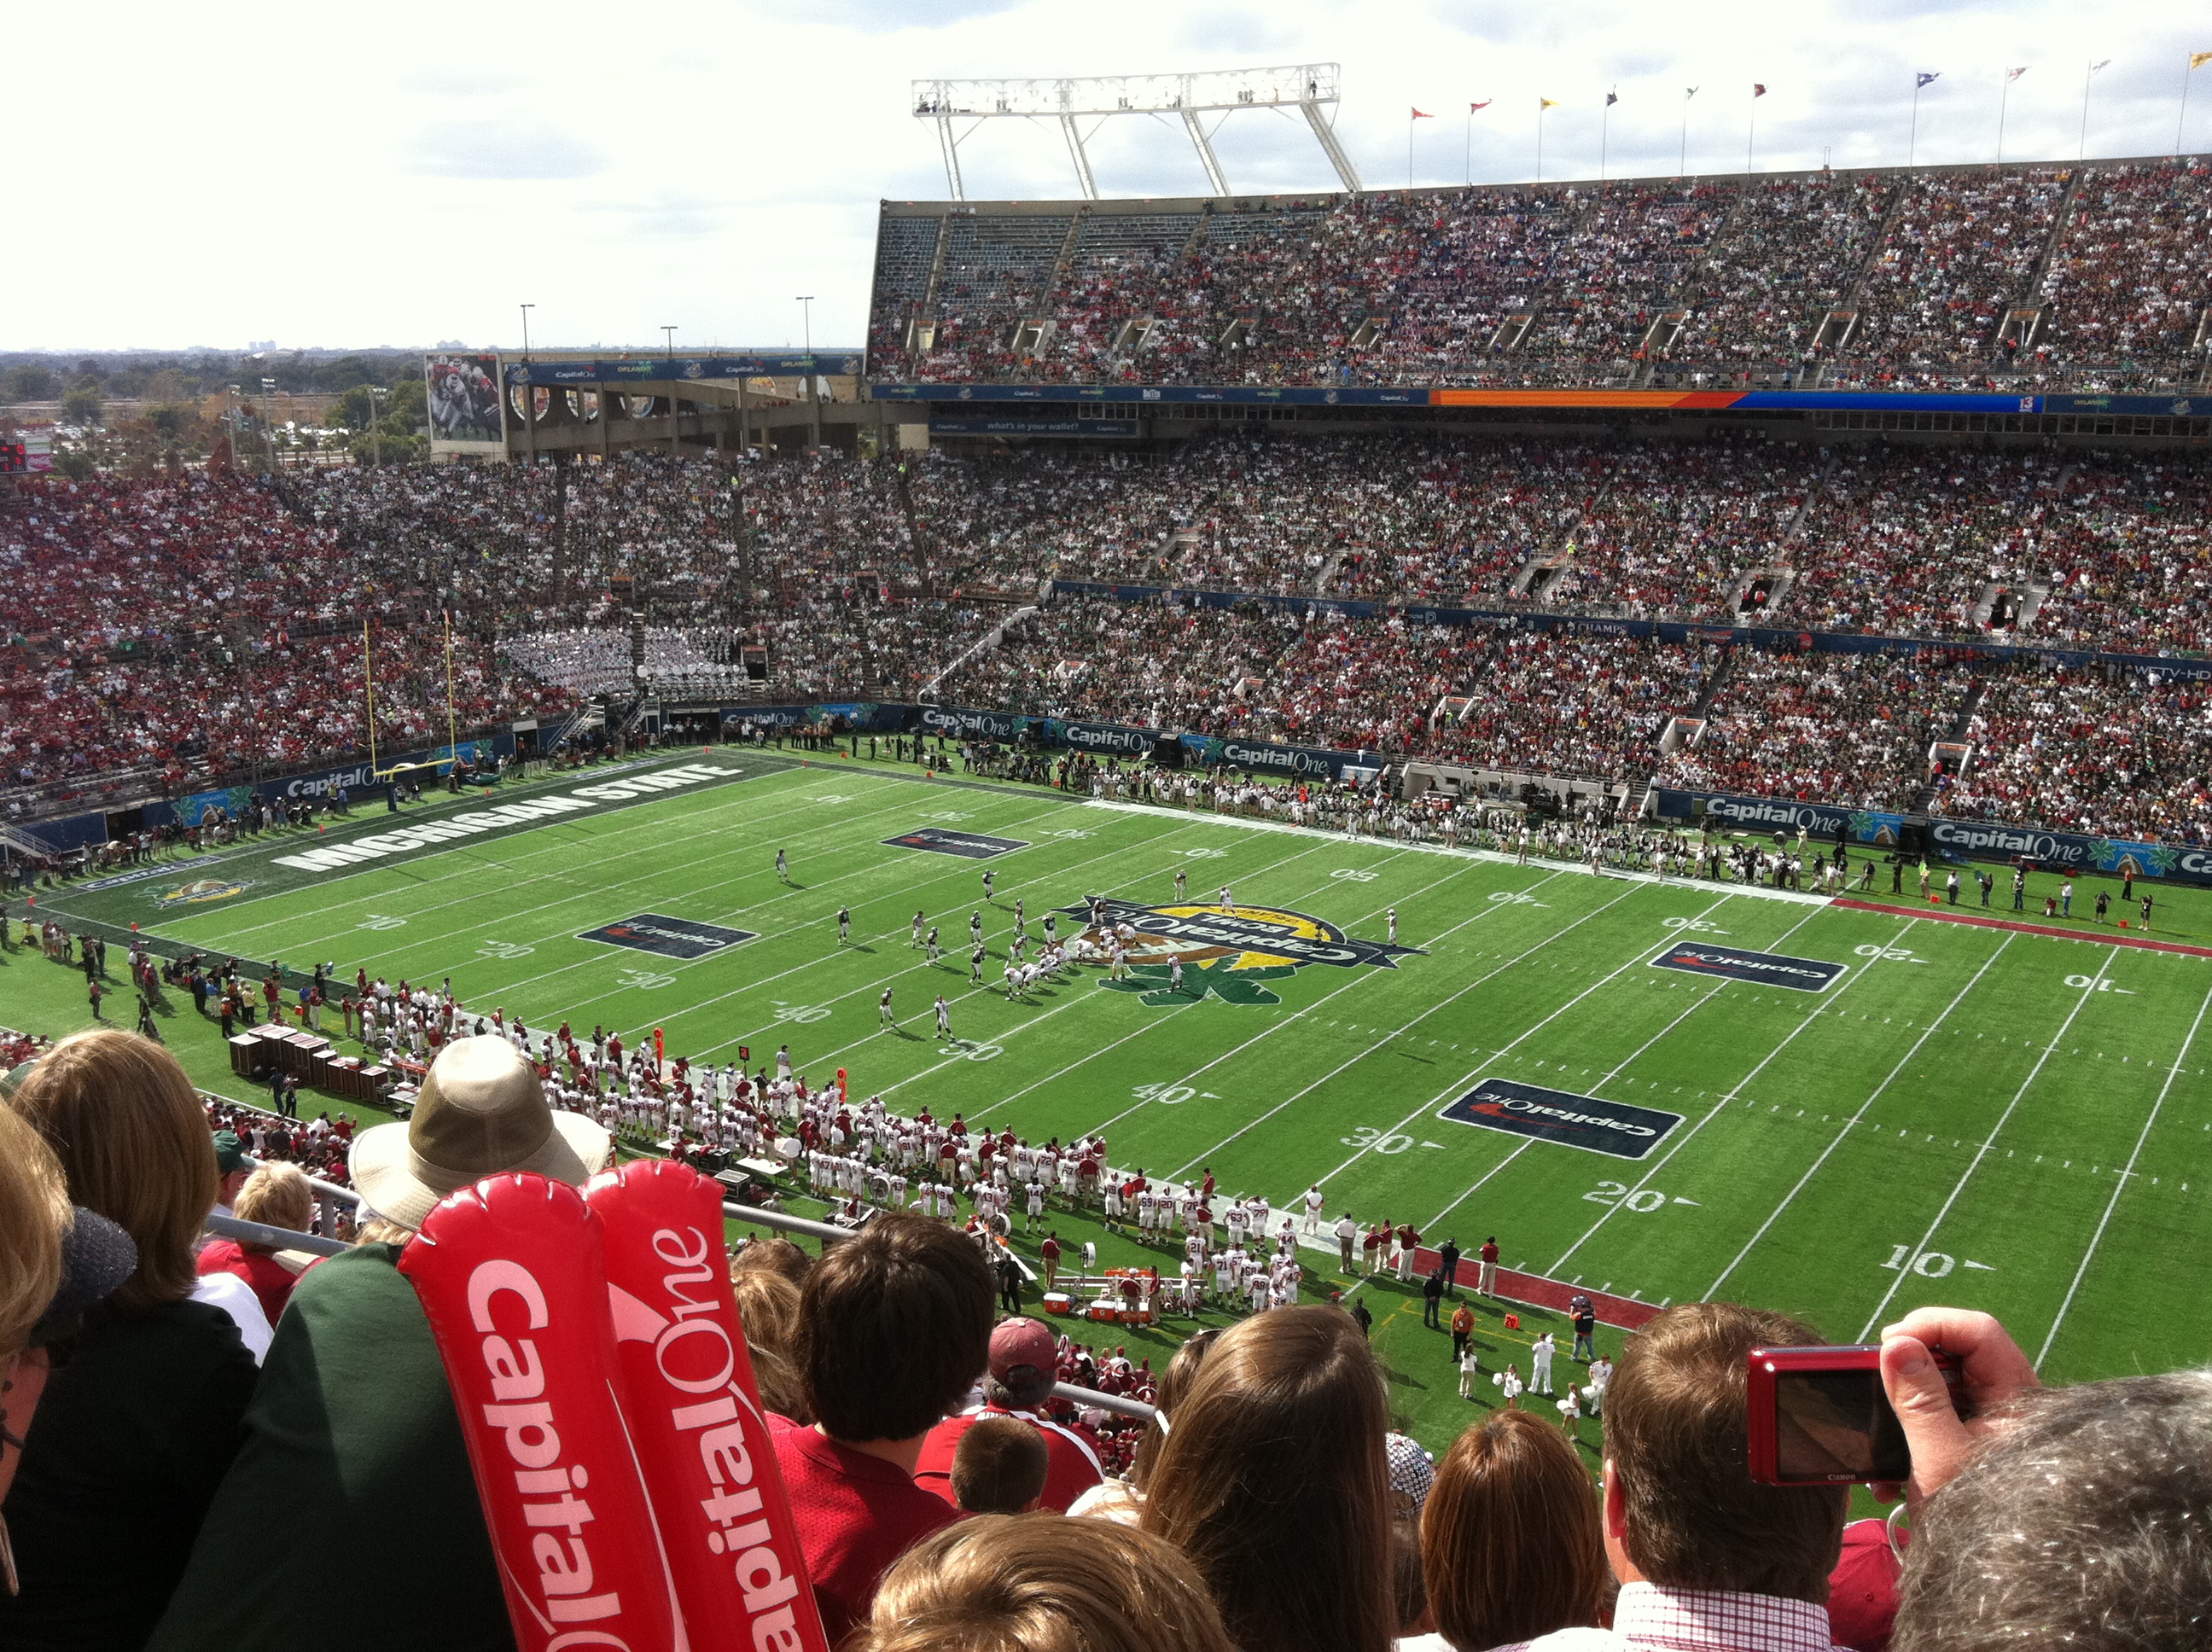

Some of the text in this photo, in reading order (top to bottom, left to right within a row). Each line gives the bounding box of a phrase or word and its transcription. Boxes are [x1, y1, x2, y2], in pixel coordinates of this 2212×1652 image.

[988, 422, 1015, 431] what's
[1017, 422, 1026, 430] in
[1027, 422, 1047, 432] your
[725, 713, 799, 725] CpitalOne
[923, 709, 1010, 737] CapitalOne
[1067, 725, 1155, 753] CapitalOn
[1224, 744, 1329, 774] CapitalOne
[269, 763, 746, 872] MICHIGAN STATE
[1707, 798, 1842, 834] CapitalOne
[1933, 823, 2083, 862] CapitalOne
[1329, 868, 1380, 882] 50
[1487, 892, 1539, 905] 40
[1198, 914, 1289, 934] BOWL
[1661, 917, 1717, 932] 30
[1103, 908, 1359, 962] CapitalOne
[474, 942, 536, 960] 20
[1853, 945, 1914, 961] 20
[1674, 949, 1828, 979] CapitalOne
[616, 971, 678, 990] 30
[2064, 974, 2116, 992] 10
[773, 1005, 833, 1024] 40
[939, 1038, 1004, 1061] 50
[1132, 1082, 1196, 1104] 40
[1475, 1092, 1657, 1137] CapitalOne
[1339, 1126, 1415, 1155] 30
[1040, 1156, 1052, 1166] 72
[1161, 1200, 1173, 1209] 20
[1581, 1180, 1667, 1213] 20
[1230, 1213, 1243, 1223] 63
[1190, 1242, 1202, 1253] 21
[1281, 1235, 1293, 1245] 44
[1217, 1260, 1227, 1271] 71
[1880, 1244, 1956, 1278] 10
[1504, 1315, 1518, 1329] 20
[467, 1258, 628, 1652] Capital
[1828, 1473, 1856, 1481] Canon
